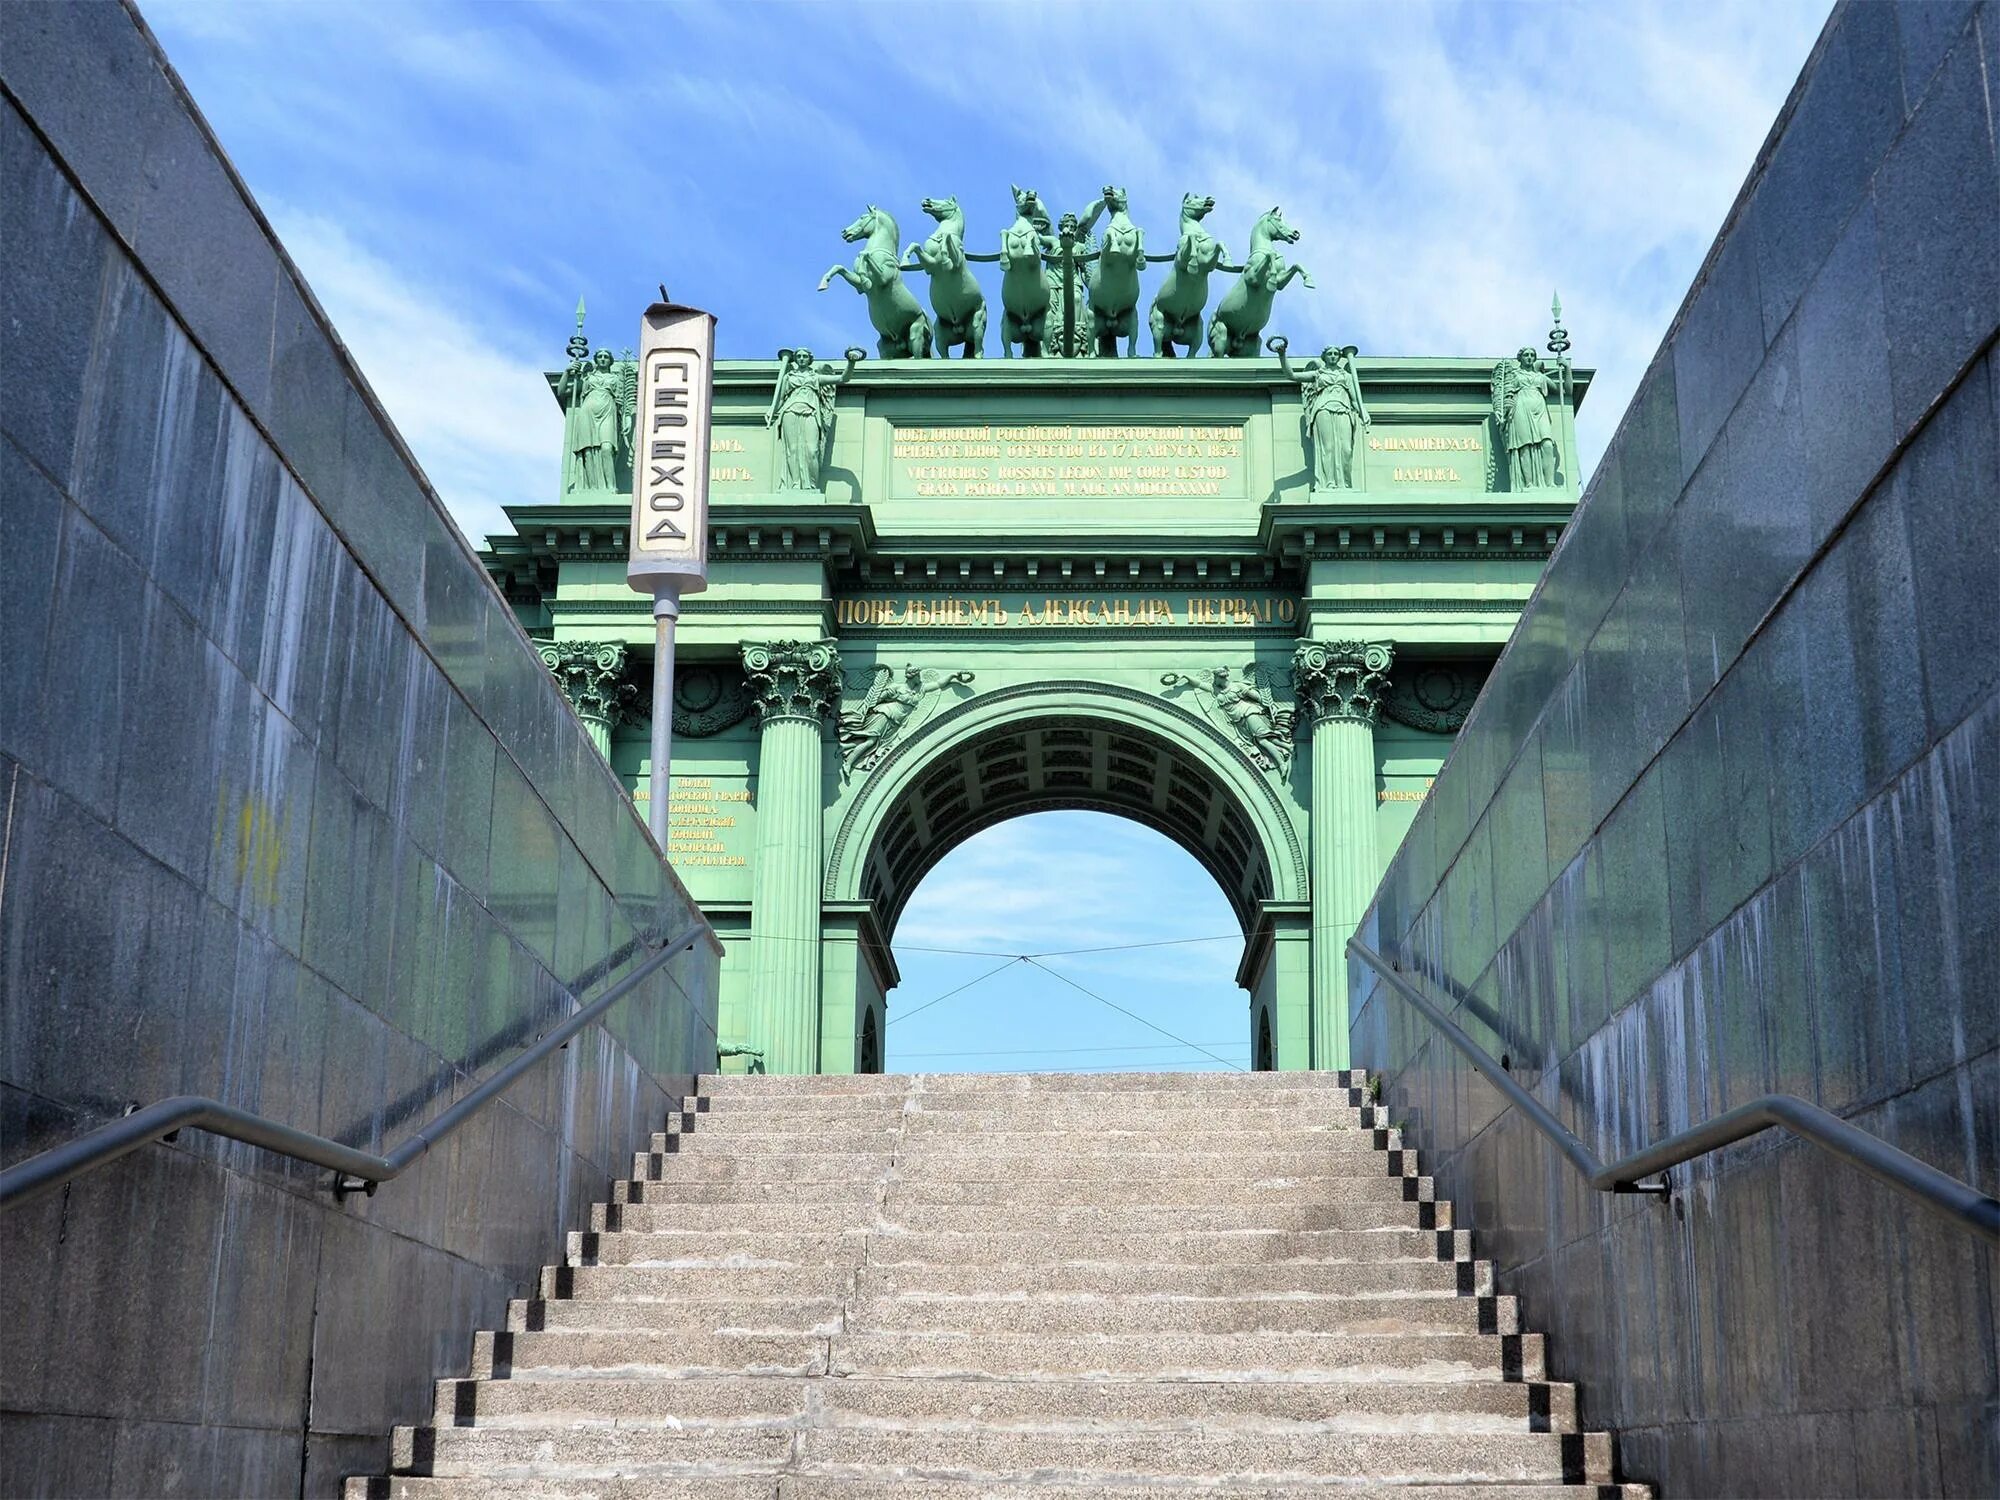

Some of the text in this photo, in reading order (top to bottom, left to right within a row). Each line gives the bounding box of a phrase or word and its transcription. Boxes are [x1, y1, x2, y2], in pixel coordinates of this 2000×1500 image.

[645, 362, 689, 540] ПЕРЕХОД
[893, 444, 1001, 459] ПРИЗНАТЕЛЬНОЕ
[1007, 444, 1083, 459] ОТЕЧЕСТВО
[1088, 444, 1108, 458] ВЪ
[1112, 444, 1127, 458] 17
[1145, 444, 1203, 458] АВГУСТА
[907, 466, 990, 481] VICTRICIBUS
[998, 466, 1054, 480] ROSSICIS
[837, 595, 1009, 626] ПОВЕЛѢНІЕМЪ
[1017, 598, 1176, 627] АЛЕКСАНДРА
